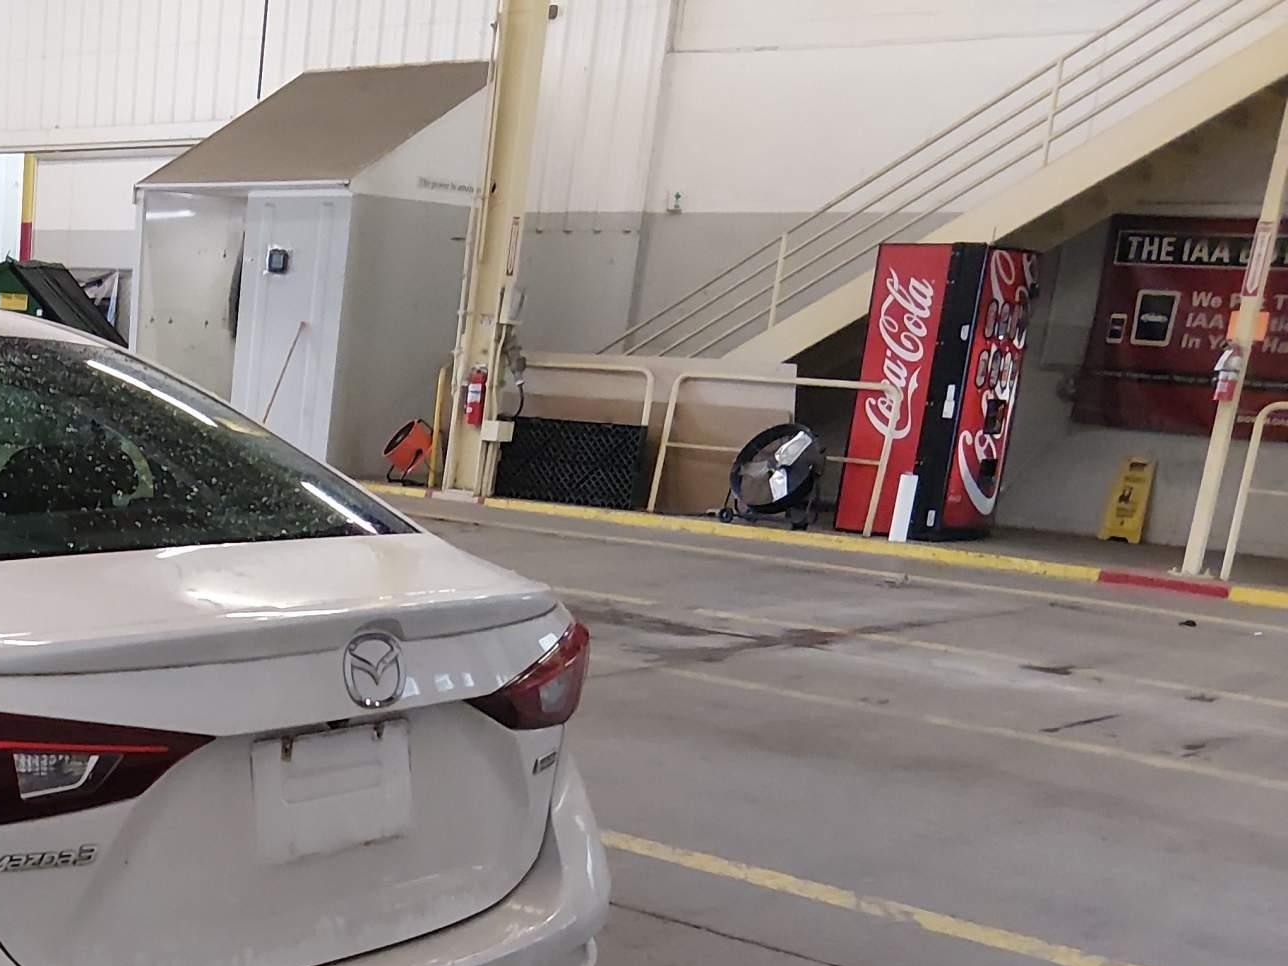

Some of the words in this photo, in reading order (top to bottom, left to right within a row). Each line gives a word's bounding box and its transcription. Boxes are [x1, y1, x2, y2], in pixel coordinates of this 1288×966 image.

[1128, 236, 1177, 261] THE
[1182, 238, 1230, 263] IAA
[1191, 291, 1223, 309] We
[1185, 313, 1224, 328] IAA
[1180, 333, 1201, 349] In
